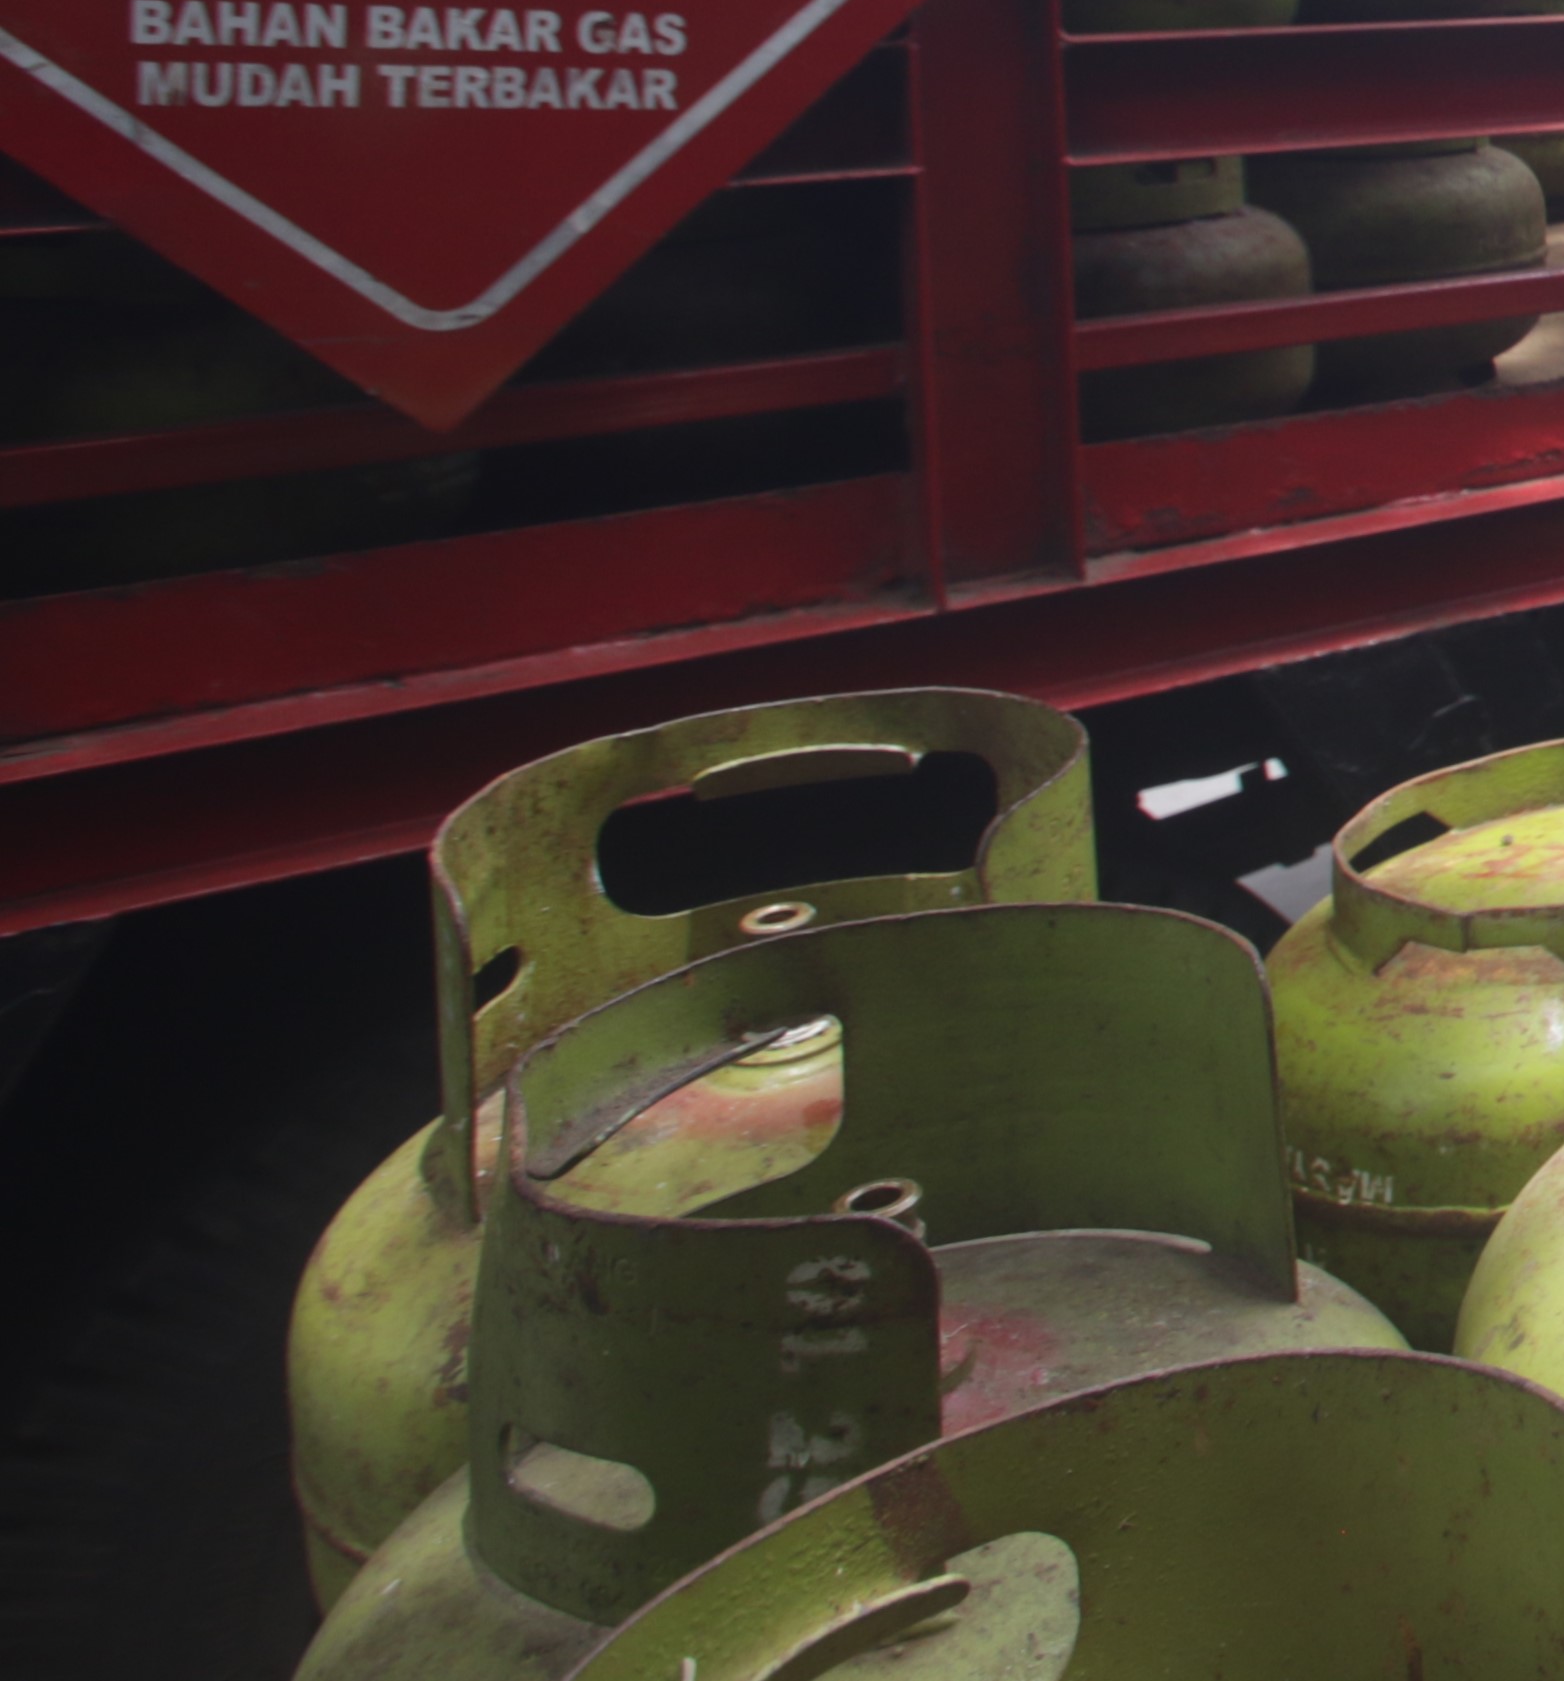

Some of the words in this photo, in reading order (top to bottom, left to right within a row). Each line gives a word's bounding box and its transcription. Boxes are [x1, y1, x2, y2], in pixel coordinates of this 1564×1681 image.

[365, 6, 563, 54] BAKAR
[577, 11, 687, 56] GAS
[138, 61, 361, 108] MUDAH
[377, 64, 678, 112] TERBAKAR
